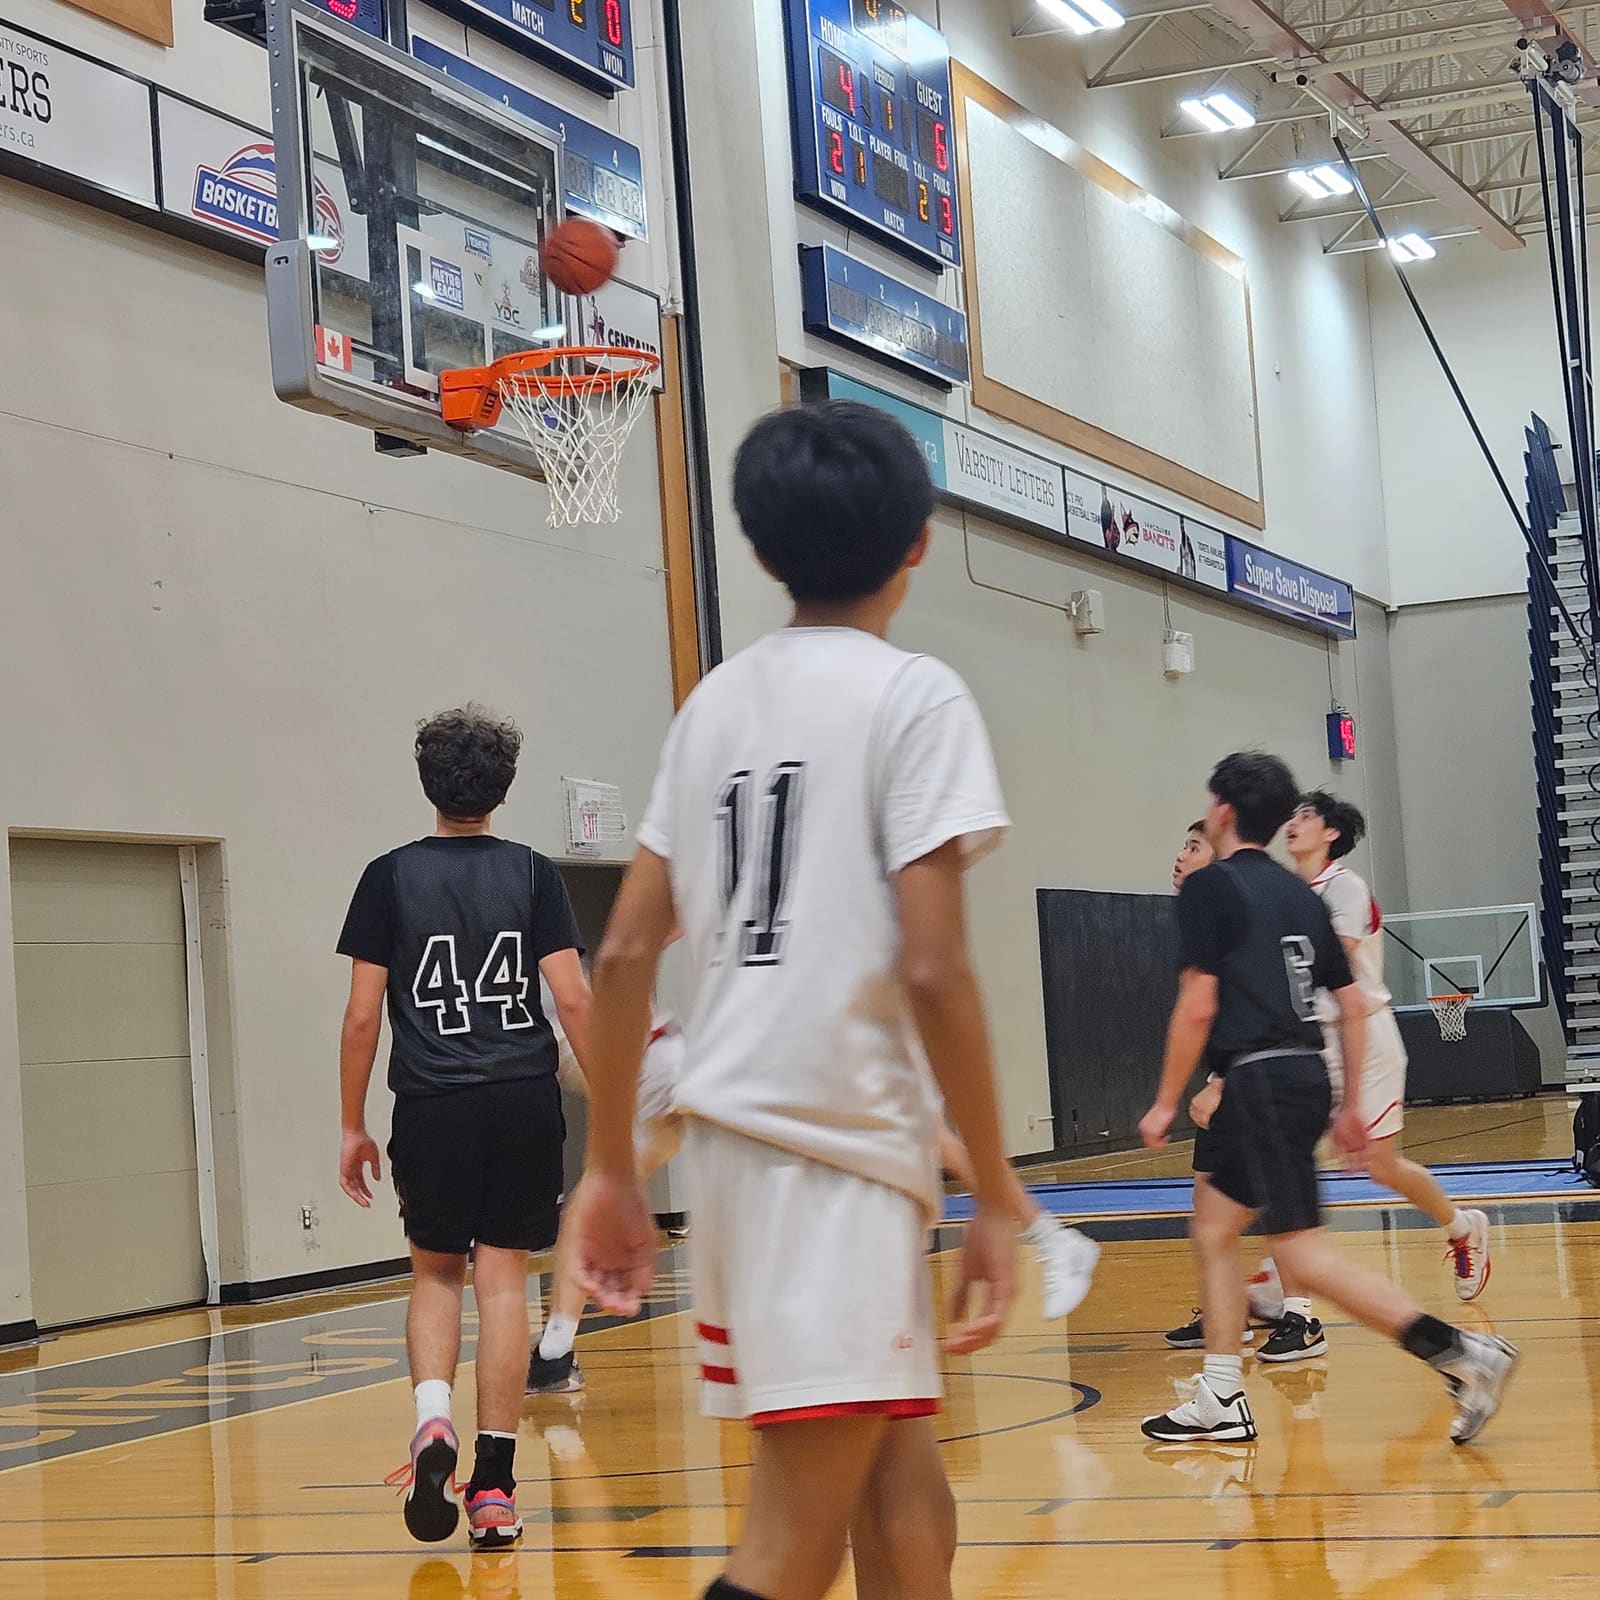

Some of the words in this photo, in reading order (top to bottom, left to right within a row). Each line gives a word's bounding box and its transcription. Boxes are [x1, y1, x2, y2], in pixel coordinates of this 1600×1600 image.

[512, 1, 544, 35] MATCH
[606, 0, 622, 45] 0
[16, 43, 48, 66] SPORTS
[603, 50, 623, 77] WON
[839, 64, 854, 113] 4
[916, 81, 943, 116] GUEST
[822, 108, 842, 131] FOULS
[560, 122, 565, 142] 3
[613, 150, 618, 167] 4
[832, 132, 843, 173] 2
[870, 135, 892, 160] PLAYER
[894, 150, 909, 170] FOUL
[831, 180, 846, 200] WON
[919, 183, 928, 221] 2
[934, 175, 950, 195] FOULS
[202, 179, 279, 229] BASKETB
[884, 209, 904, 233] MATCH
[943, 197, 952, 234] 3
[940, 240, 953, 257] WON
[843, 266, 848, 282] 1
[879, 284, 884, 300] 2
[914, 302, 919, 316] 3
[494, 302, 520, 324] YDC
[954, 432, 1003, 487] VARSITY
[1008, 465, 1055, 507] LETTERS
[1143, 528, 1174, 551] BANDITS
[1245, 554, 1273, 594] Super
[1276, 566, 1298, 600] Save
[1299, 576, 1338, 616] Disposal
[412, 931, 534, 1036] 44
